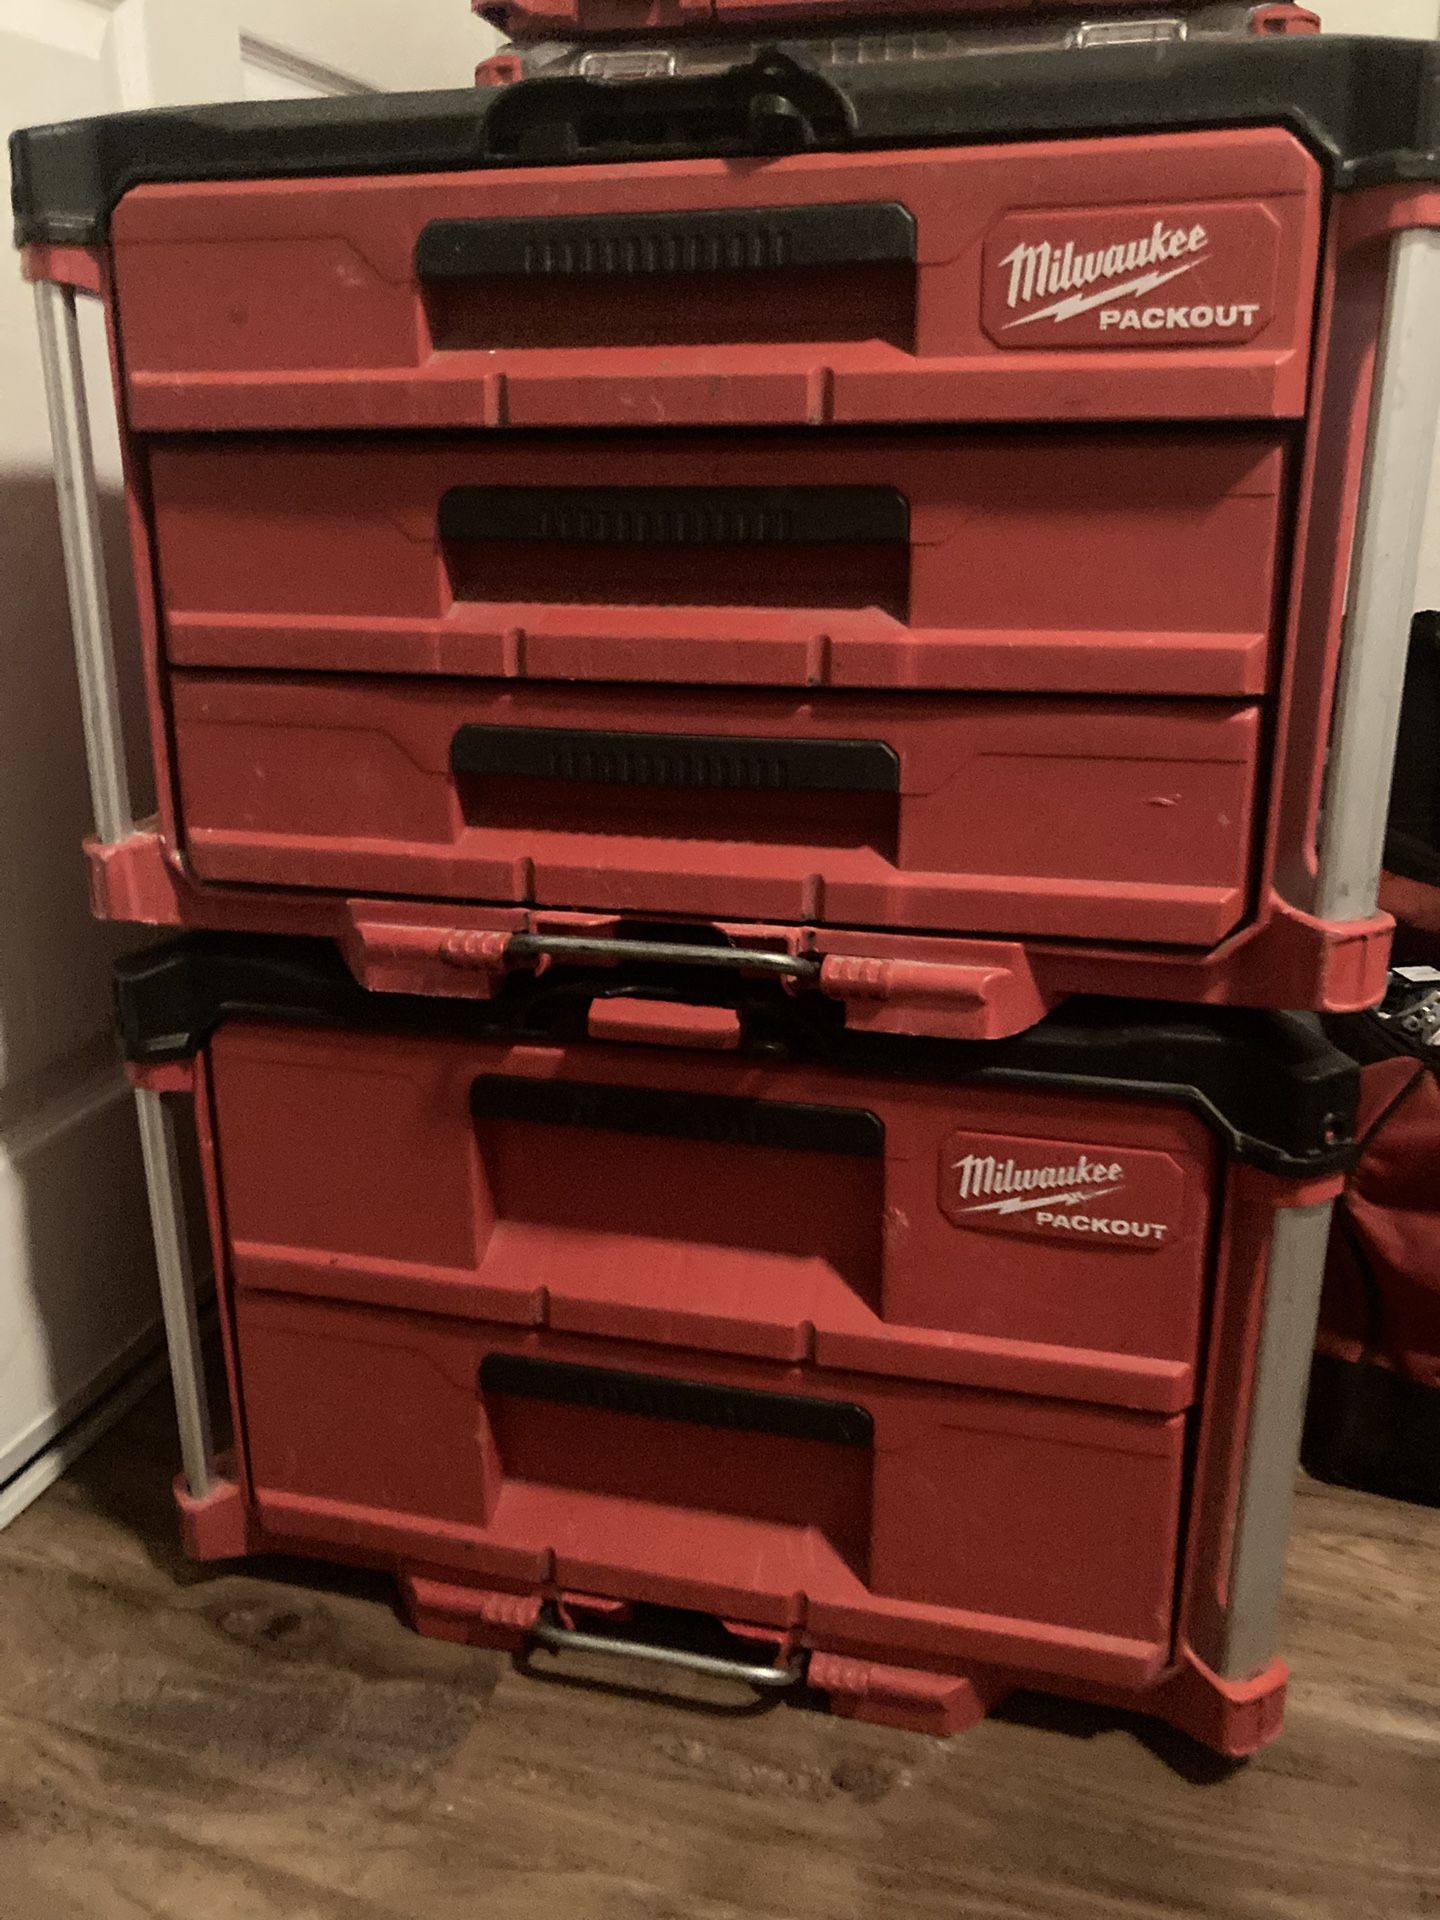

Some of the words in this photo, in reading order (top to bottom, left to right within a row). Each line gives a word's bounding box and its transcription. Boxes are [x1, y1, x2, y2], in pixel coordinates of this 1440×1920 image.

[998, 221, 1208, 308] Milwaukee
[1099, 304, 1260, 331] PACKOUT
[951, 1154, 1123, 1199] Milwaukee
[1036, 1211, 1168, 1240] PACKOUT
